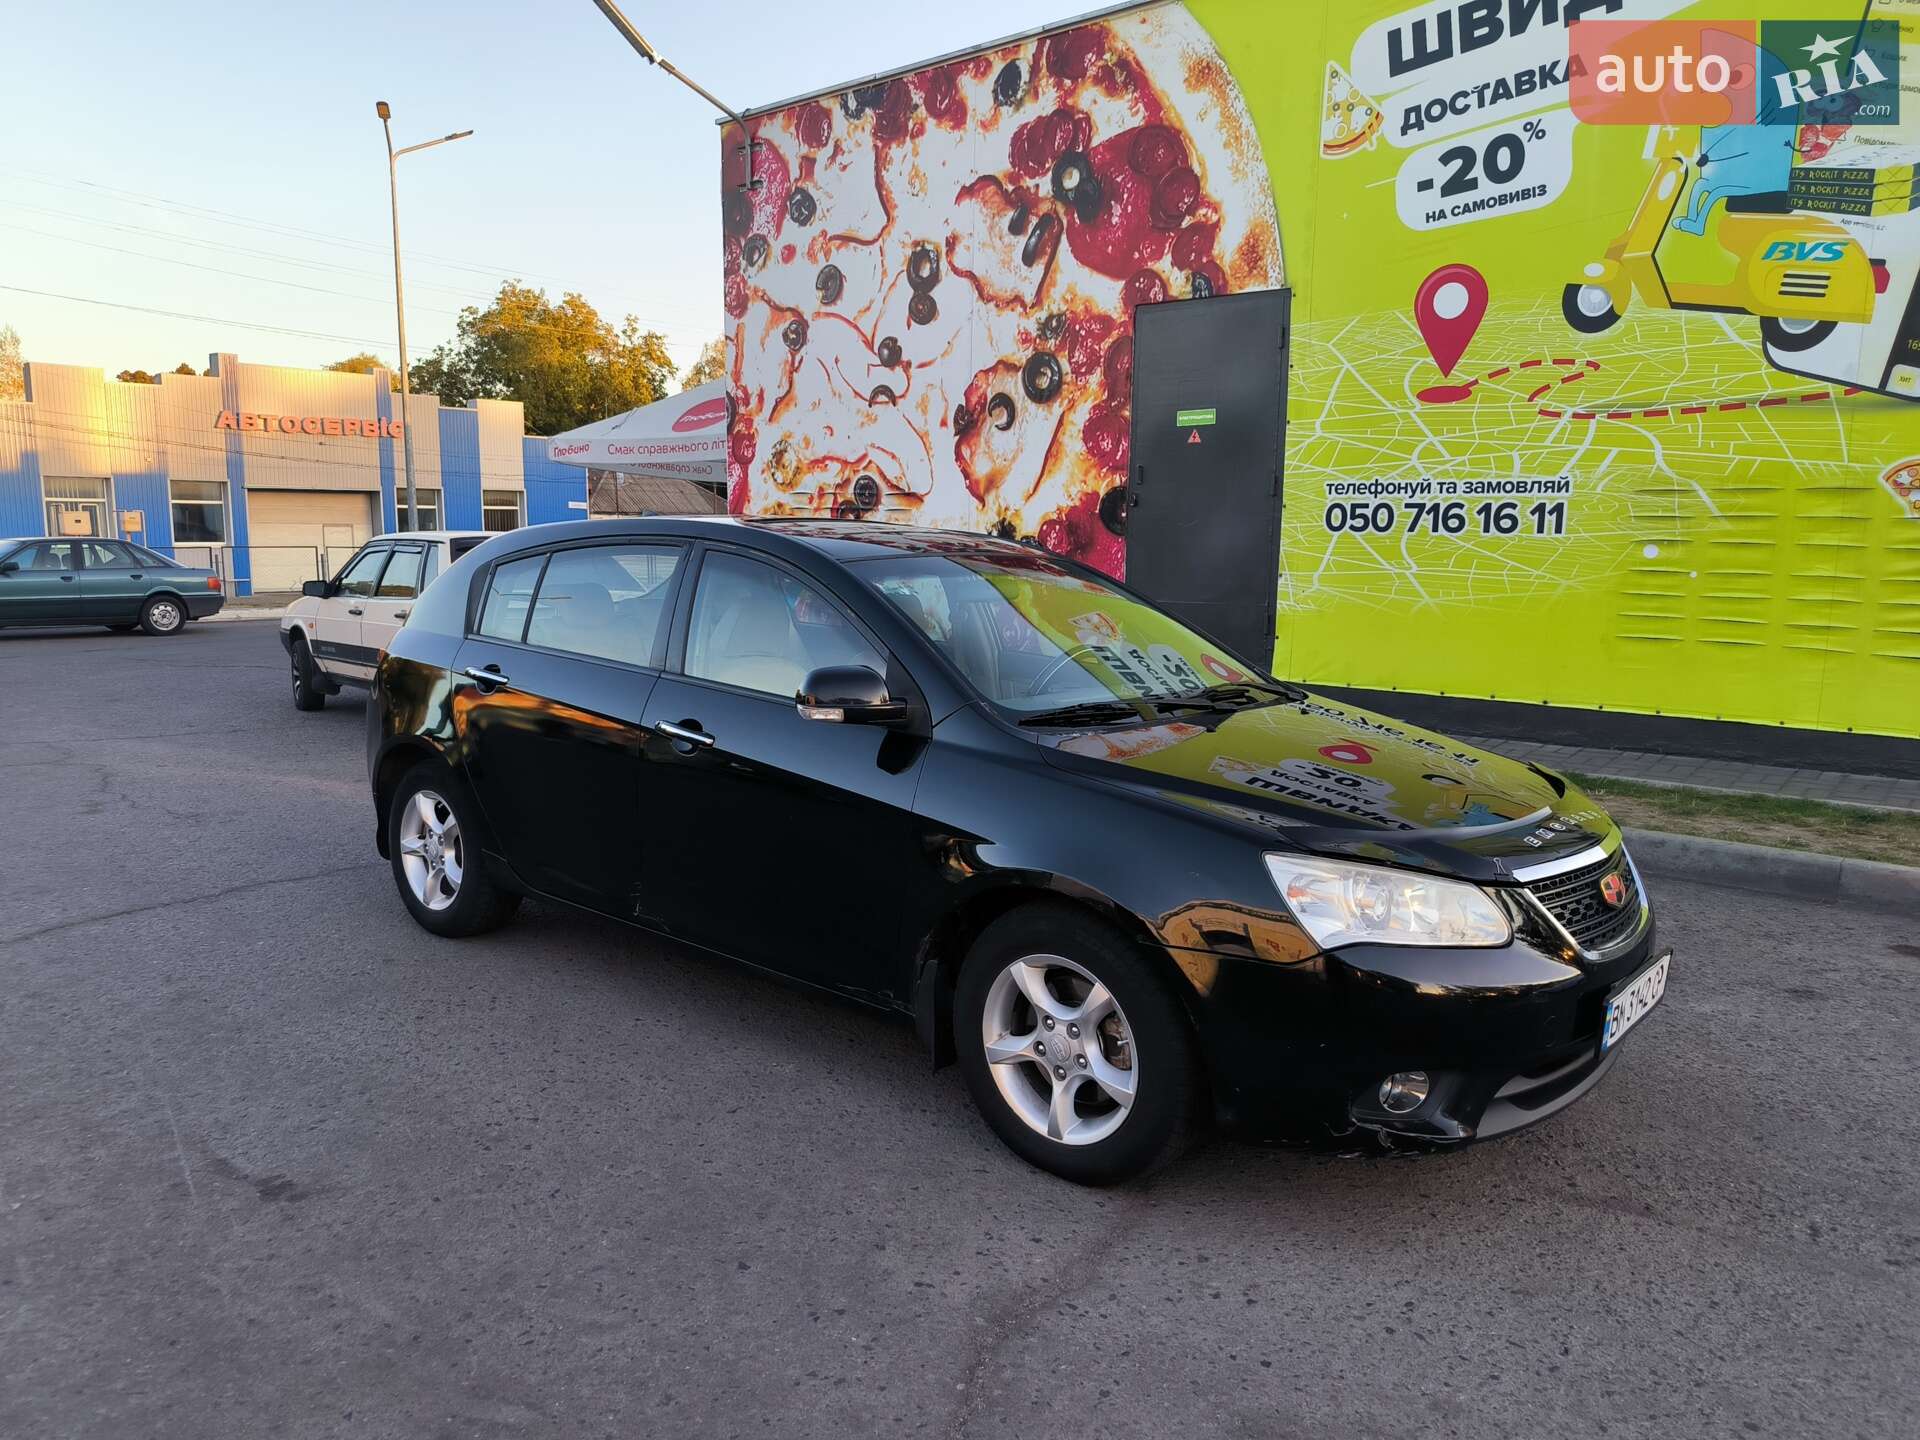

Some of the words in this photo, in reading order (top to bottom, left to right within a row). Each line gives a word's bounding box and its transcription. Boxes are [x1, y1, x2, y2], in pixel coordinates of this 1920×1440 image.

[1400, 54, 1588, 136] ДОСТАВКА
[1417, 118, 1547, 198] -20%
[1809, 170, 1839, 179] ROCKIT
[1843, 170, 1870, 180] PIZZA
[1810, 185, 1840, 195] ROCKIT
[1843, 187, 1870, 196] PIZZA
[1425, 208, 1447, 223] НА
[1450, 184, 1547, 217] САМОВИВІЗ
[1807, 200, 1837, 209] ROCKIT
[1840, 202, 1867, 213] PIZZA
[1761, 241, 1849, 262] BVS
[607, 443, 635, 455] Смак
[637, 441, 709, 457] справжнього
[1326, 478, 1432, 498] телефонуй
[1437, 480, 1457, 494] та
[1462, 475, 1570, 494] замовляй
[1325, 502, 1395, 533] 050
[1404, 502, 1467, 534] 716
[1475, 502, 1519, 534] 16
[1529, 502, 1565, 534] 11
